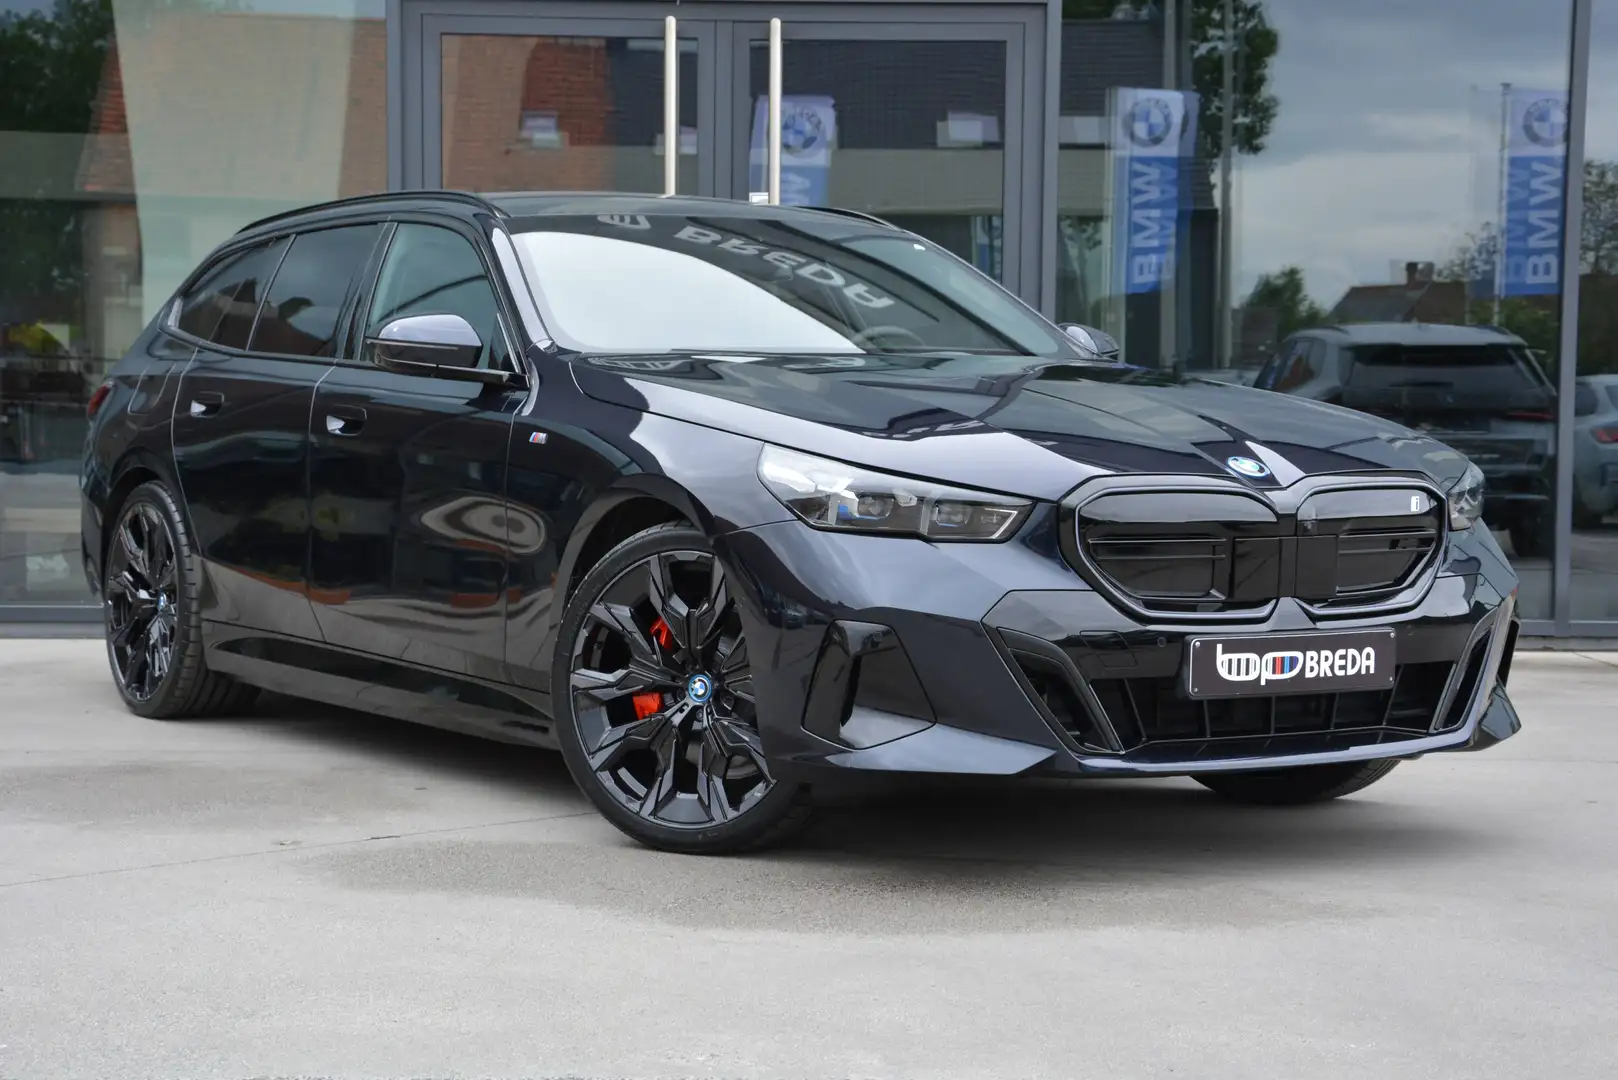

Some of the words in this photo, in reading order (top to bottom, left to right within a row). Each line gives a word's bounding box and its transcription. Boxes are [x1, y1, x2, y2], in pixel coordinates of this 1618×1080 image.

[1130, 161, 1162, 284] BMW
[1526, 160, 1562, 284] BMW
[1305, 646, 1375, 678] BREDA
